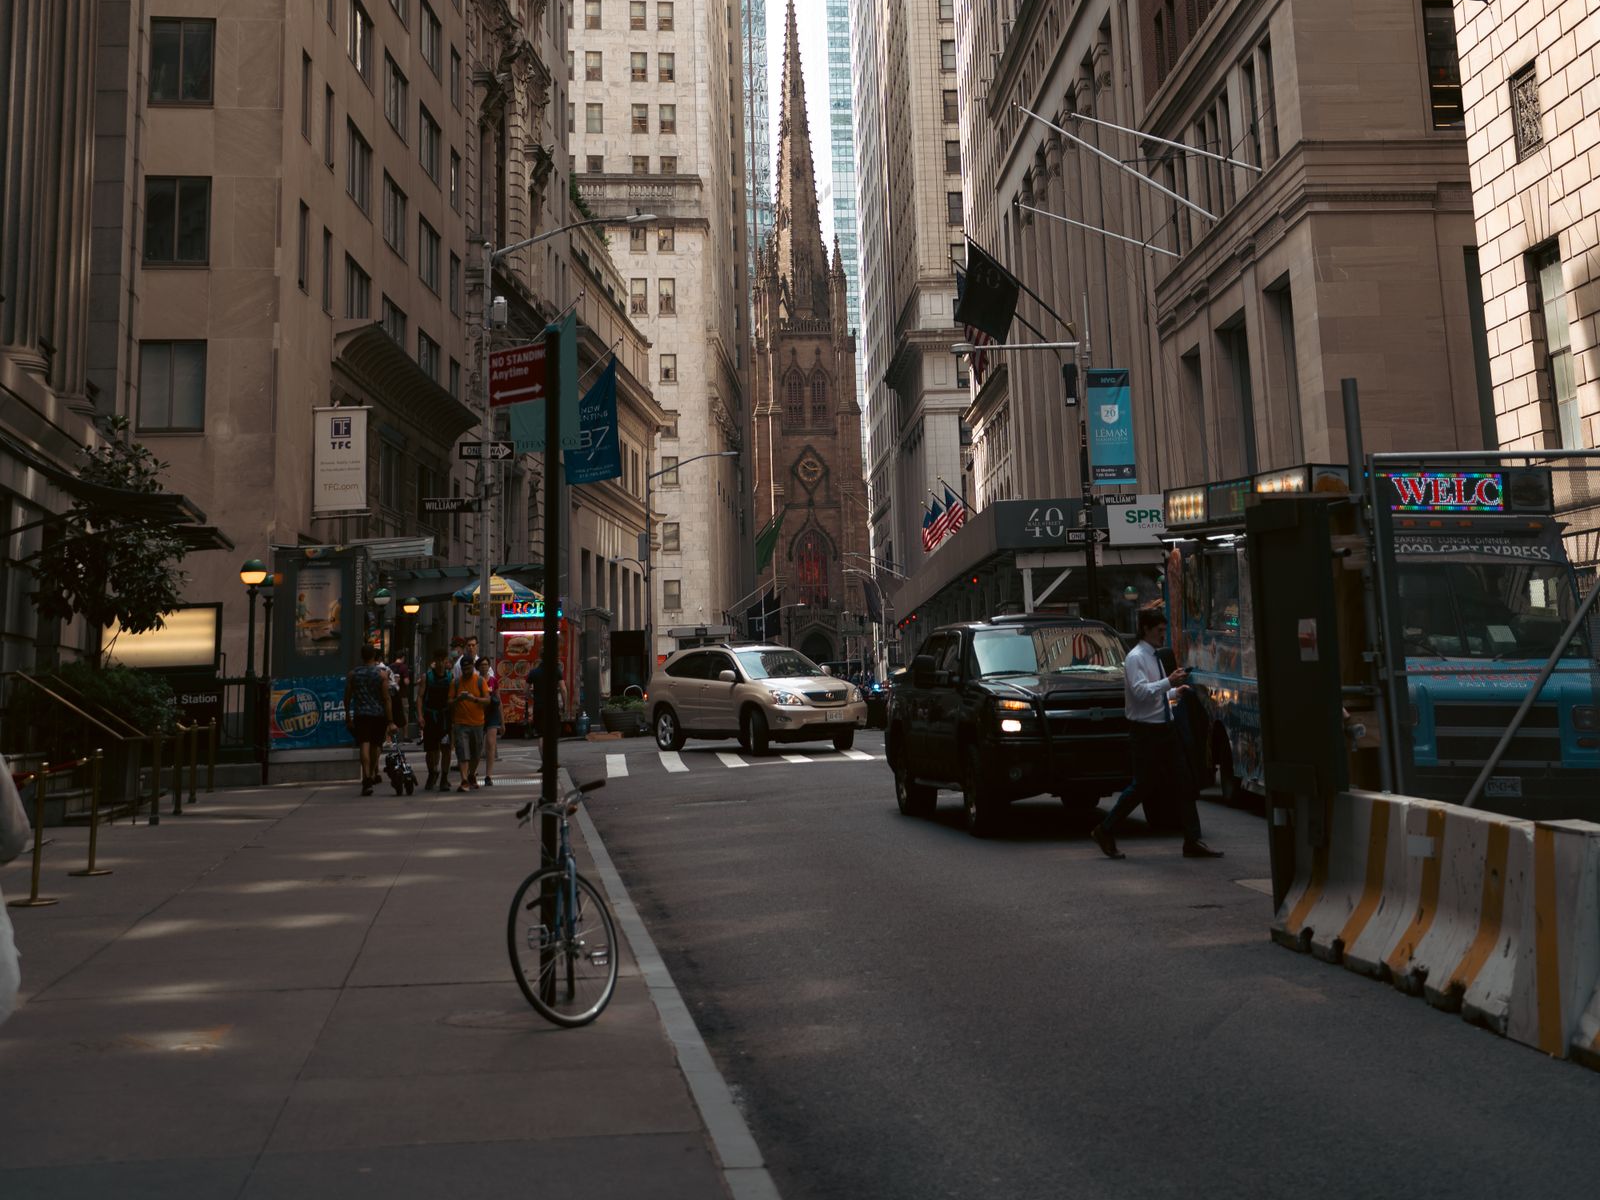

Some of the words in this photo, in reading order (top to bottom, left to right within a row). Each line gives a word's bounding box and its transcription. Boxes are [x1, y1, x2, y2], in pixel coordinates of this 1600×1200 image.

[492, 356, 505, 368] NO
[492, 366, 529, 381] Anytime
[582, 410, 609, 421] NTING
[331, 441, 351, 450] TFC
[516, 440, 547, 449] TIFFAN
[491, 447, 506, 455] WAY
[323, 483, 359, 491] TFC.com
[1391, 477, 1500, 505] WELC
[425, 501, 457, 510] WILLIAM
[1105, 496, 1131, 504] WILLIAM
[1025, 507, 1064, 537] 40
[1125, 509, 1162, 524] SPR
[1394, 536, 1433, 544] EAKFAST
[1438, 537, 1471, 545] LUNCH
[1475, 537, 1511, 545] DINNER
[1483, 545, 1550, 560] EXPRESS
[355, 555, 364, 606] Newsstand
[181, 693, 218, 704] Station
[324, 701, 346, 711] PLA
